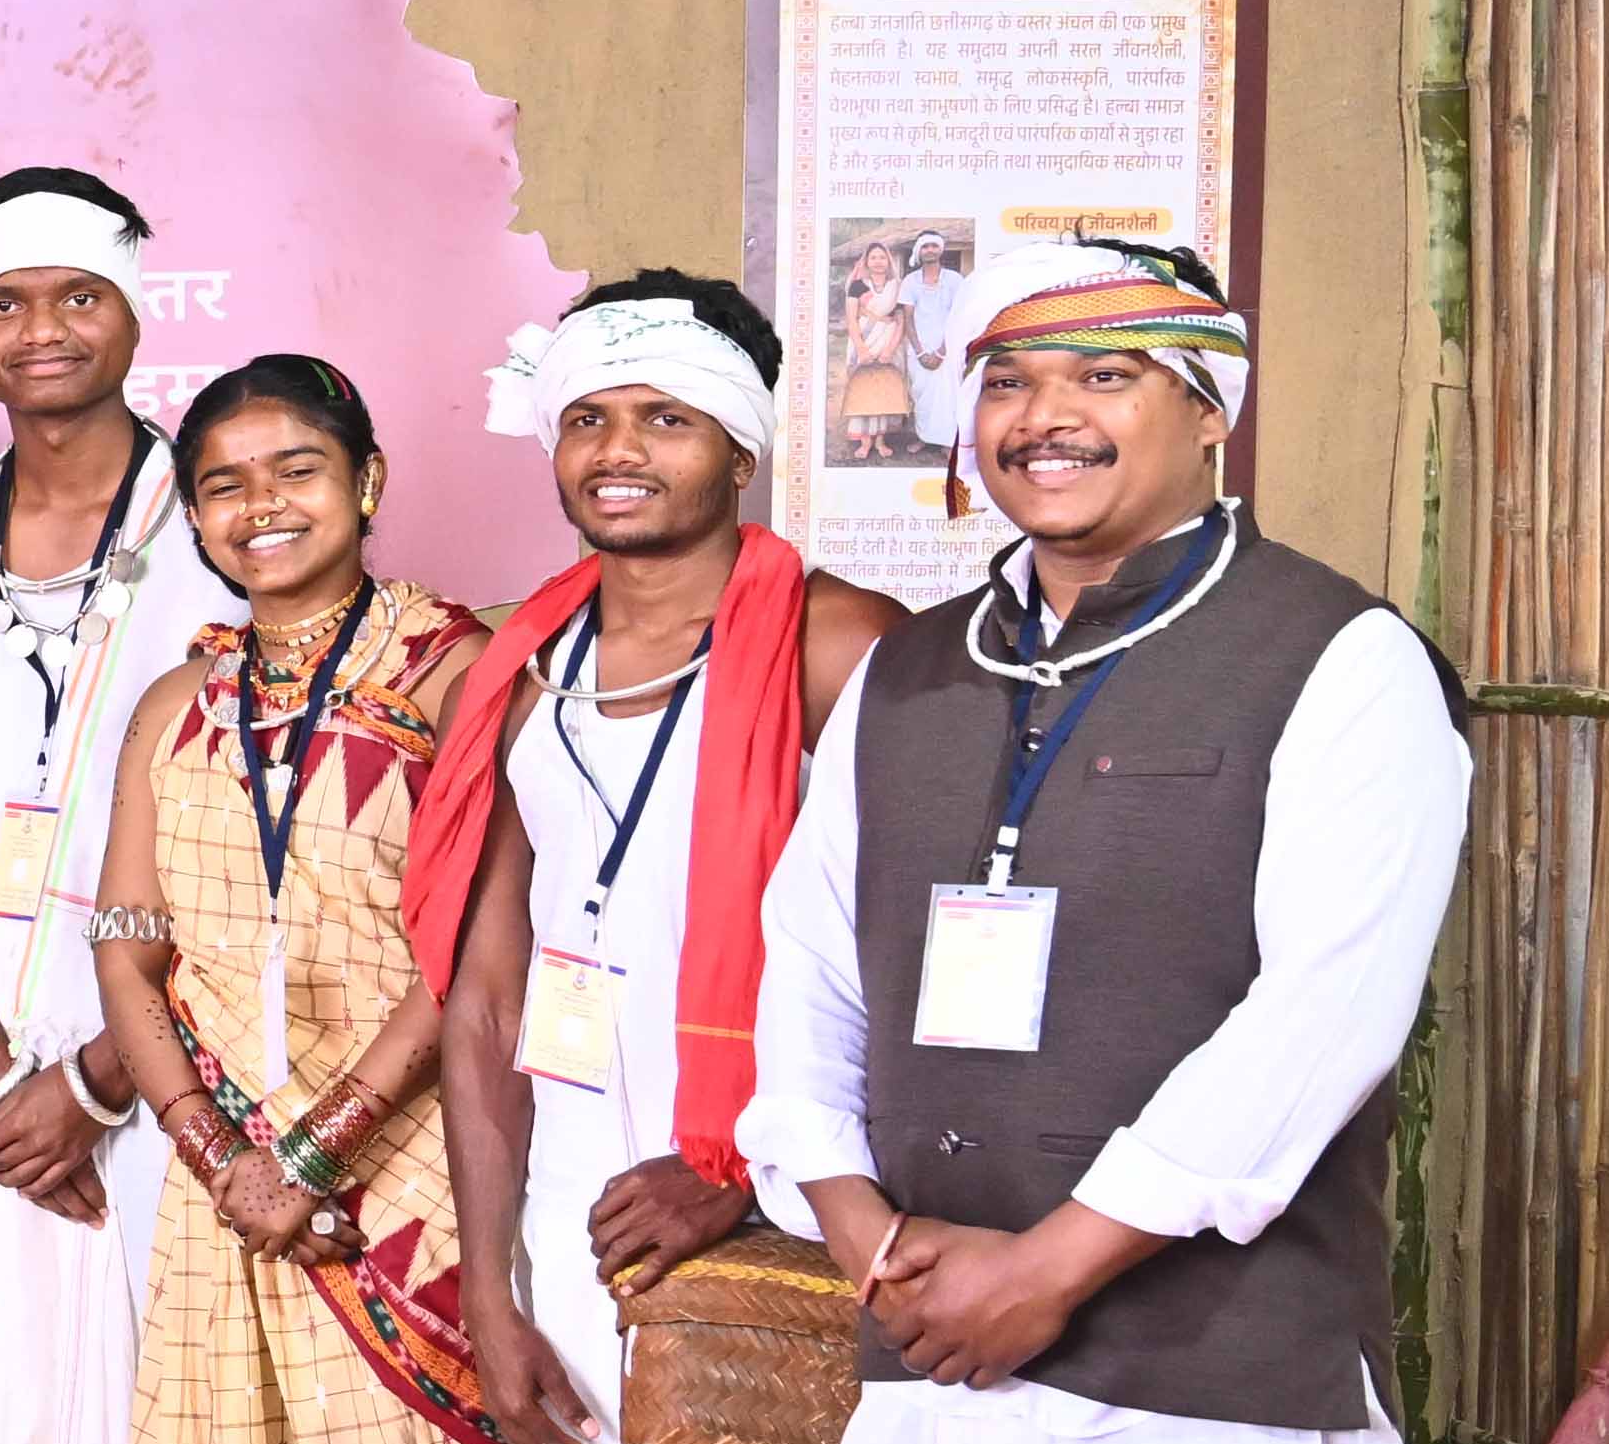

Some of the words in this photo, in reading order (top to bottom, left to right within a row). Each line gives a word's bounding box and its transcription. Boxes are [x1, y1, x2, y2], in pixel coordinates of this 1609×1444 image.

[830, 15, 864, 33] हल्बा
[868, 11, 925, 31] जनजाति
[930, 11, 994, 35] छत्तीसगढ़
[997, 12, 1013, 30] के
[1017, 15, 1052, 30] बस्तर
[1099, 11, 1117, 30] की
[1123, 15, 1146, 31] एक
[1151, 15, 1186, 36] प्रमुख
[830, 38, 885, 58] जनजाति
[897, 38, 912, 60] है।
[926, 43, 948, 60] यह
[958, 42, 1007, 63] समुदाय
[1018, 38, 1058, 58] अपनी
[1069, 42, 1101, 58] सरल
[830, 67, 900, 87] मेहनतकश
[976, 71, 1013, 91] समृद्ध
[1126, 67, 1185, 87] पारंपरिक
[829, 95, 880, 119] वेशभूषा
[886, 99, 913, 114] तथा
[983, 95, 998, 114] के
[1004, 94, 1031, 114] लिए
[1037, 94, 1078, 117] प्रसिद्ध
[1083, 95, 1098, 116] है।
[1106, 99, 1140, 116] हल्बा
[1145, 99, 1185, 115] समाज
[829, 126, 861, 147] मुख्य
[865, 126, 889, 140] रूप
[893, 123, 904, 140] से
[945, 122, 989, 147] मजदूरी
[993, 123, 1013, 141] एवं
[1017, 122, 1076, 142] पारंपरिक
[1118, 123, 1129, 142] से
[1133, 127, 1159, 147] जुड़ा
[1163, 127, 1184, 144] रहा
[844, 149, 868, 169] और
[872, 154, 911, 171] इनका
[917, 150, 954, 170] जीवन
[958, 150, 998, 175] प्रकृति
[1004, 154, 1030, 170] तथा
[1036, 150, 1109, 175] सामुदायिक
[1114, 150, 1162, 171] सहयोग
[1166, 155, 1183, 170] पर
[829, 177, 885, 196] आधारित
[889, 176, 904, 198] है।
[1014, 212, 1059, 230] परिचय
[1088, 212, 1158, 231] जीवनशैली
[854, 514, 904, 531] जनजाति
[908, 515, 921, 531] के
[818, 539, 857, 558] दिखाई
[861, 539, 885, 557] देती
[889, 539, 903, 556] है।
[908, 542, 927, 556] यह
[931, 539, 977, 560] वेशभूषा
[905, 584, 943, 602] पहनते
